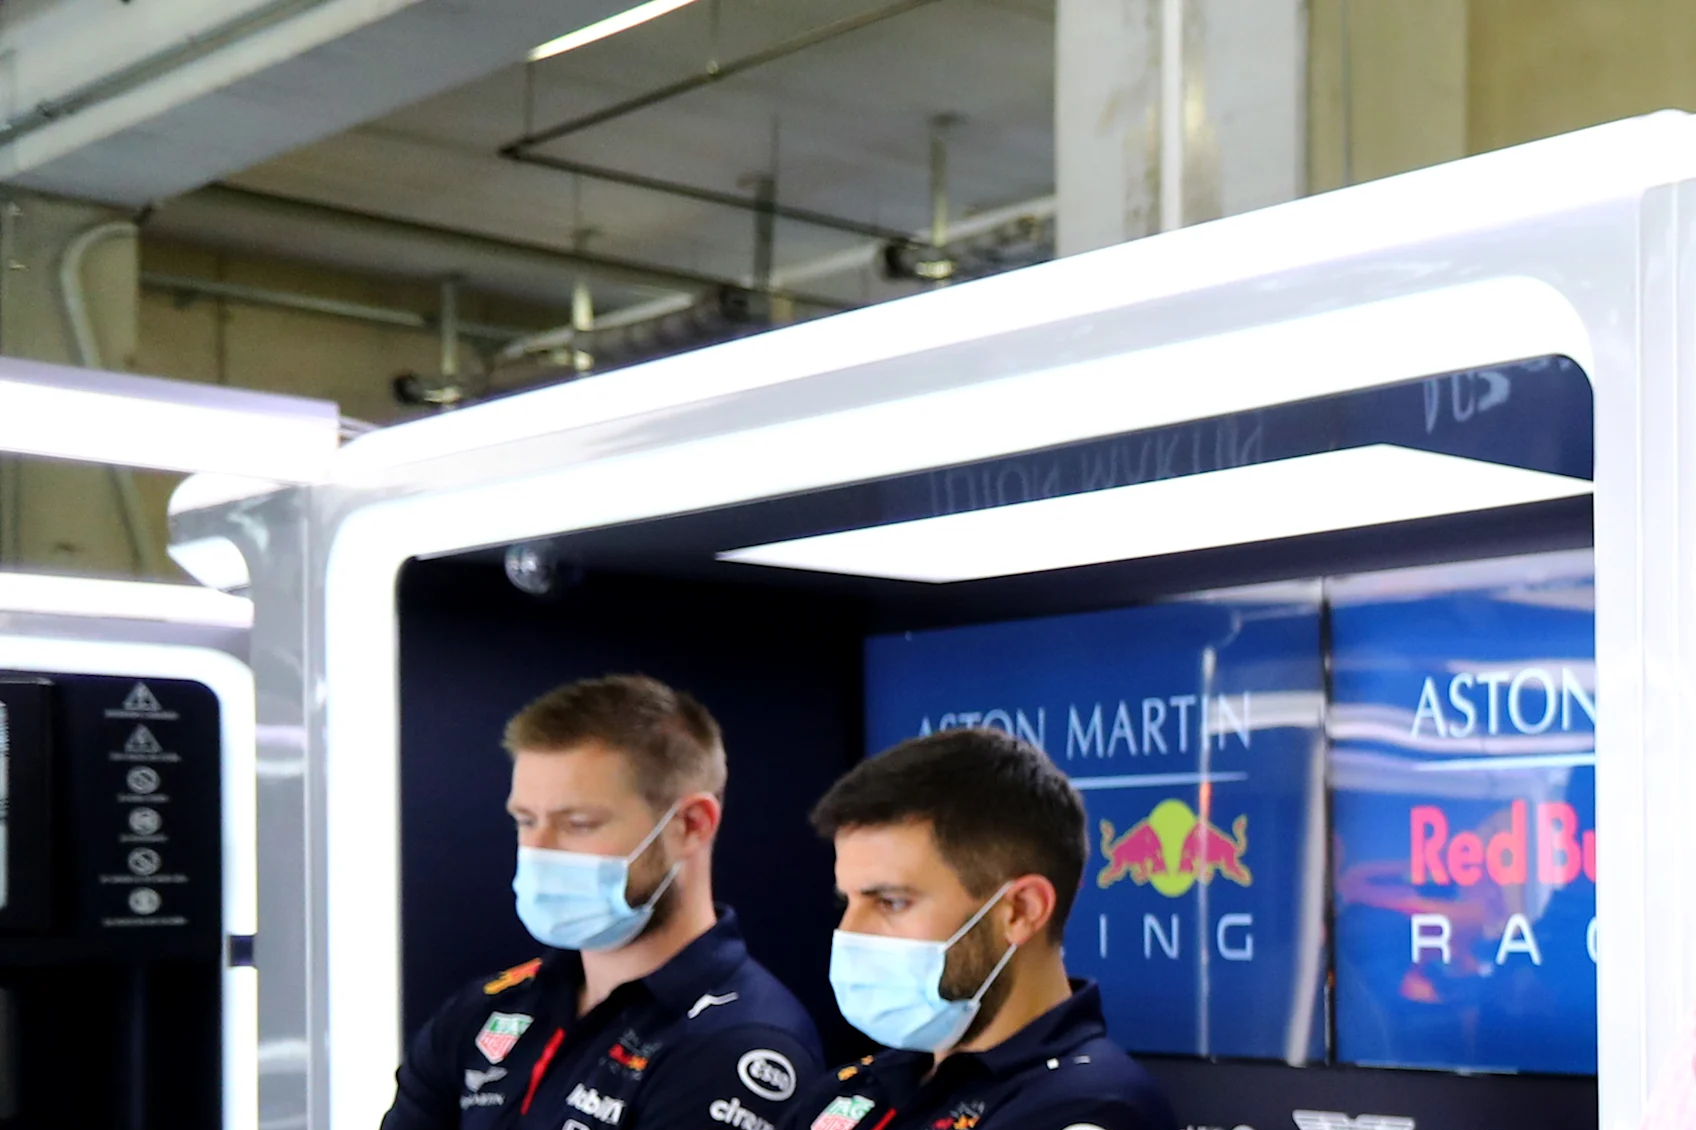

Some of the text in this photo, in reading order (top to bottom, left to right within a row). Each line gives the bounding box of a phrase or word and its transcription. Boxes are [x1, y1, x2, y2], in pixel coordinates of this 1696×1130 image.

[1066, 690, 1252, 760] MARTIN
[1410, 666, 1596, 739] ASTON
[1410, 798, 1528, 886] Red
[1099, 913, 1253, 962] ING
[1410, 912, 1598, 966] RA
